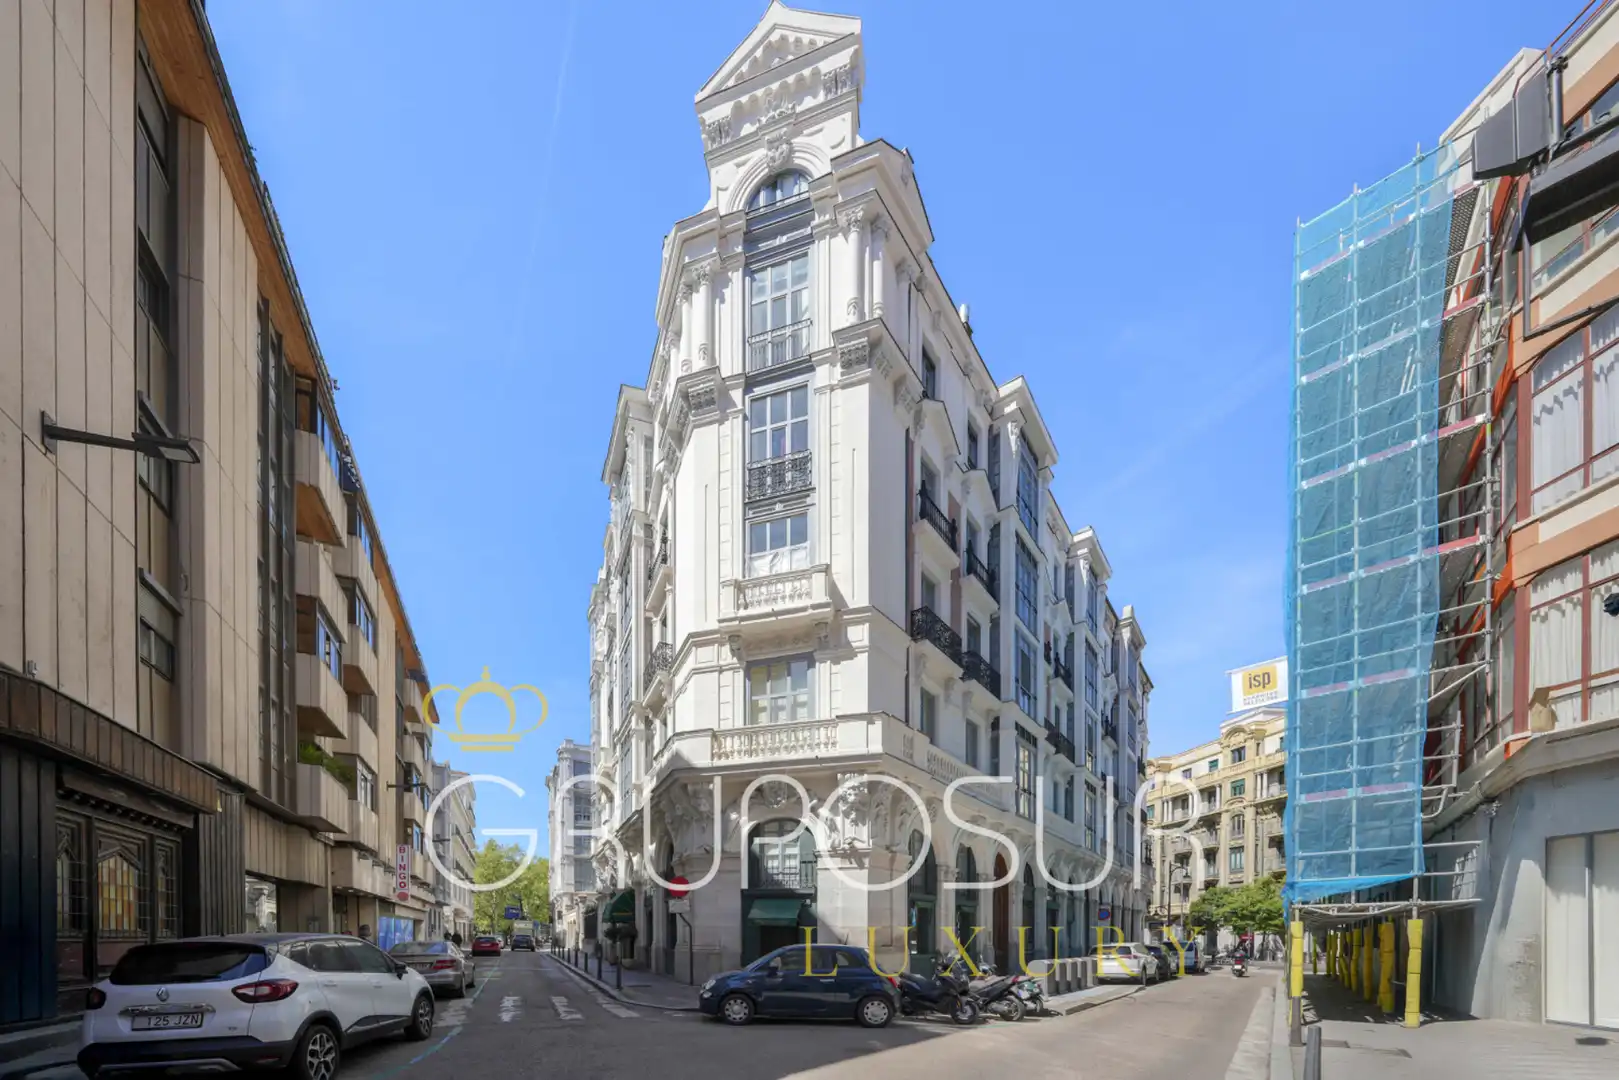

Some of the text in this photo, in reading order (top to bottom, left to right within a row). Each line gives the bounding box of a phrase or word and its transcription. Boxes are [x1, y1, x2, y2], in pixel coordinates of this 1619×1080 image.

[1248, 671, 1271, 689] isp
[398, 846, 407, 889] BINGO
[173, 1014, 200, 1026] JZN
